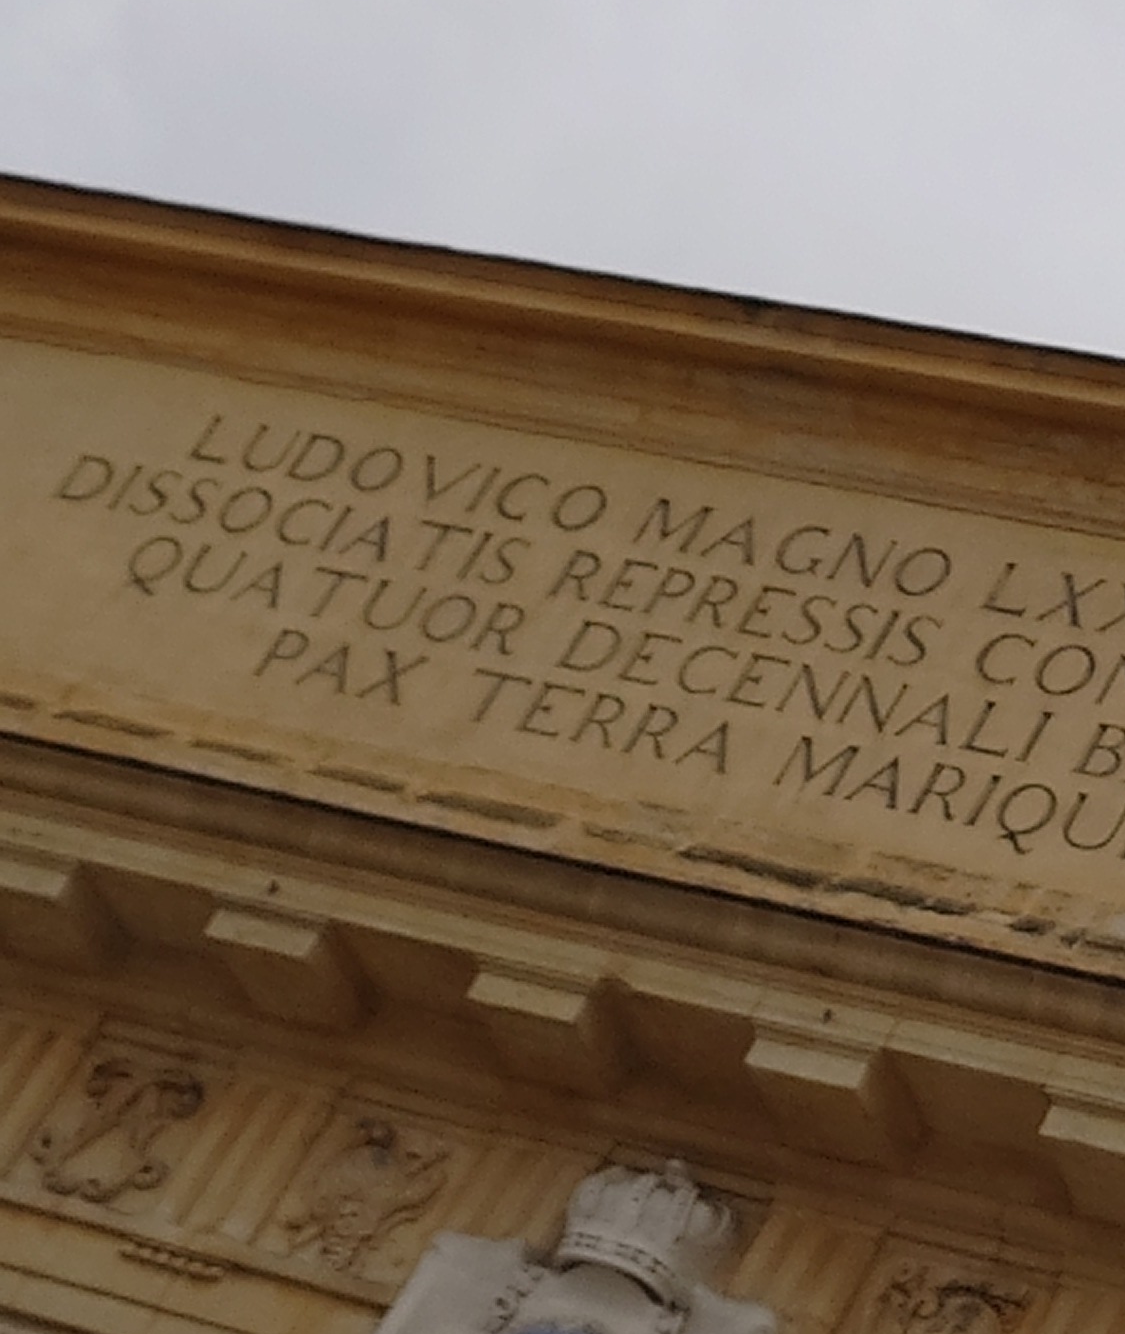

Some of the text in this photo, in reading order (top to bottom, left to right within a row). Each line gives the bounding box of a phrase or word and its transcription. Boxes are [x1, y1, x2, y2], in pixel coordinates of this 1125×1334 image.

[56, 454, 532, 585] DISSOCIATIS
[548, 549, 942, 668] REPRESSIS
[190, 415, 608, 533] LUDOVICO
[632, 498, 952, 597] MAGNO
[127, 535, 525, 656] QUATUOR
[558, 620, 1054, 764] DECENNALI
[254, 628, 431, 706] PAX
[470, 669, 732, 774] TERRA
